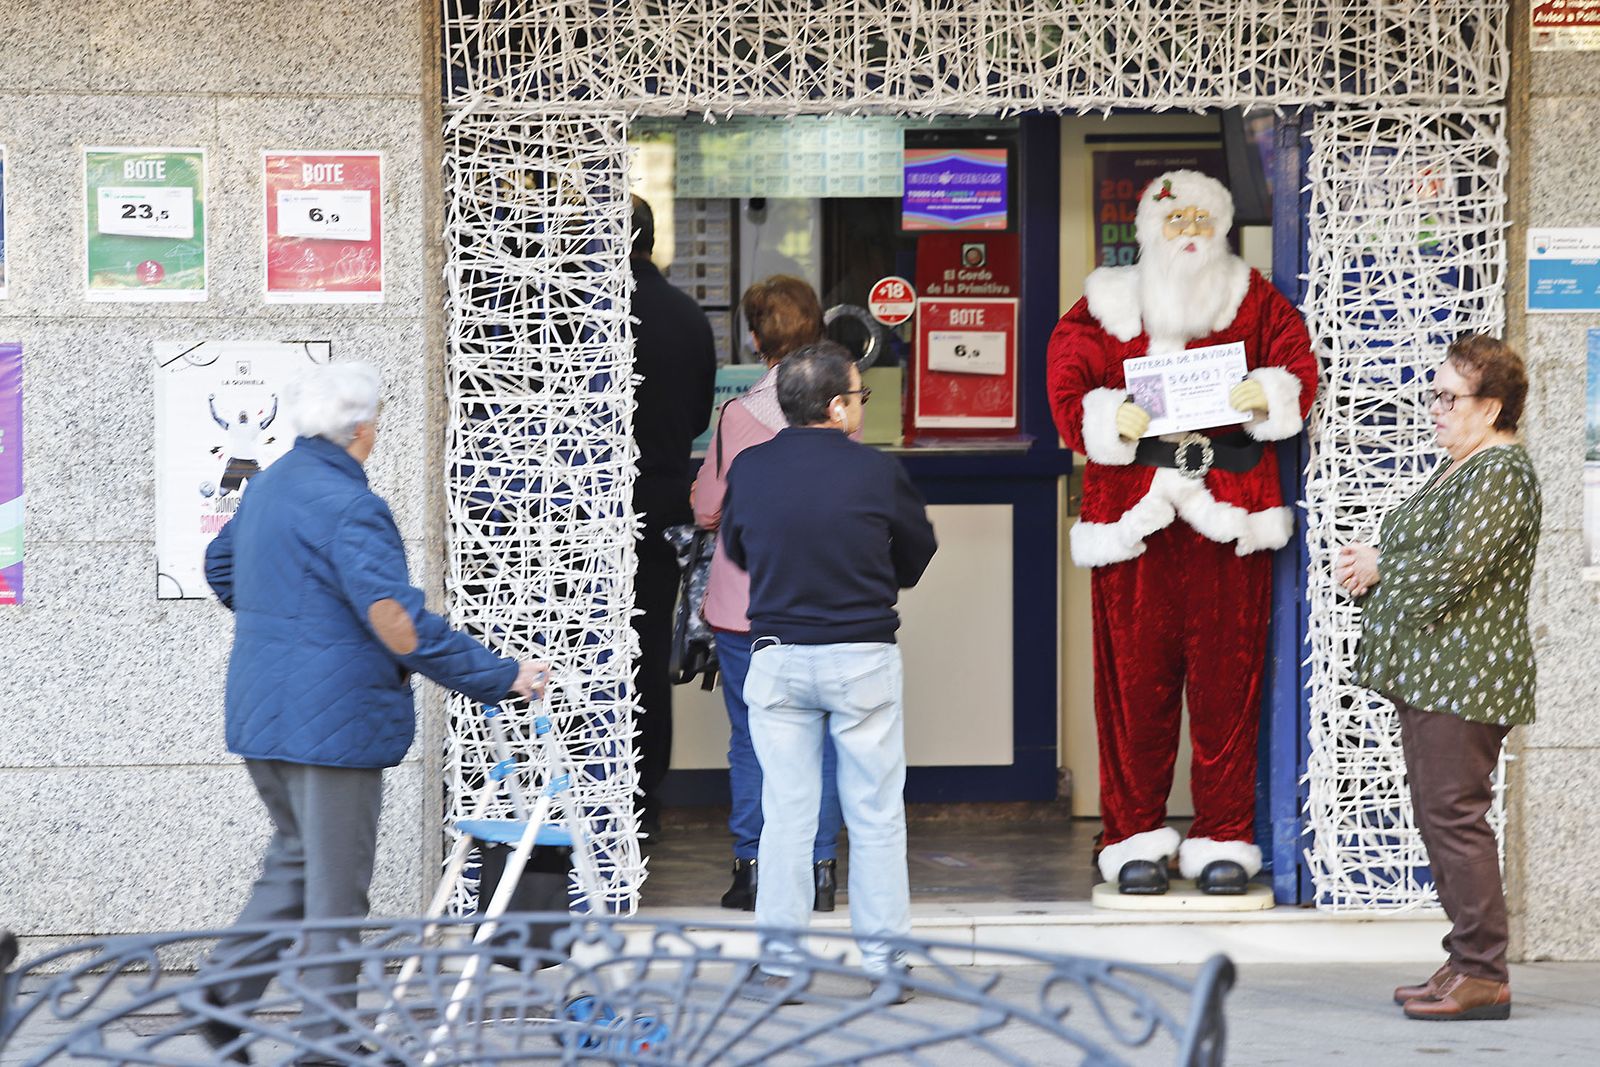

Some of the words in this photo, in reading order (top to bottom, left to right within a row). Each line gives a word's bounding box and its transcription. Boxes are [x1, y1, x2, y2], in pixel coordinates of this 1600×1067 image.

[124, 159, 167, 180] BOTE
[302, 163, 345, 184] BOTE
[121, 204, 169, 221] 23,5
[309, 208, 340, 224] 6,9
[1101, 203, 1137, 223] AL
[1102, 246, 1136, 266] 30
[944, 270, 955, 281] El
[958, 270, 992, 281] Gordo
[879, 283, 905, 298] +18
[927, 284, 941, 294] de
[944, 284, 954, 294] la
[957, 284, 1010, 294] Primitiva
[950, 309, 985, 326] BOTE
[954, 344, 981, 358] 6,9
